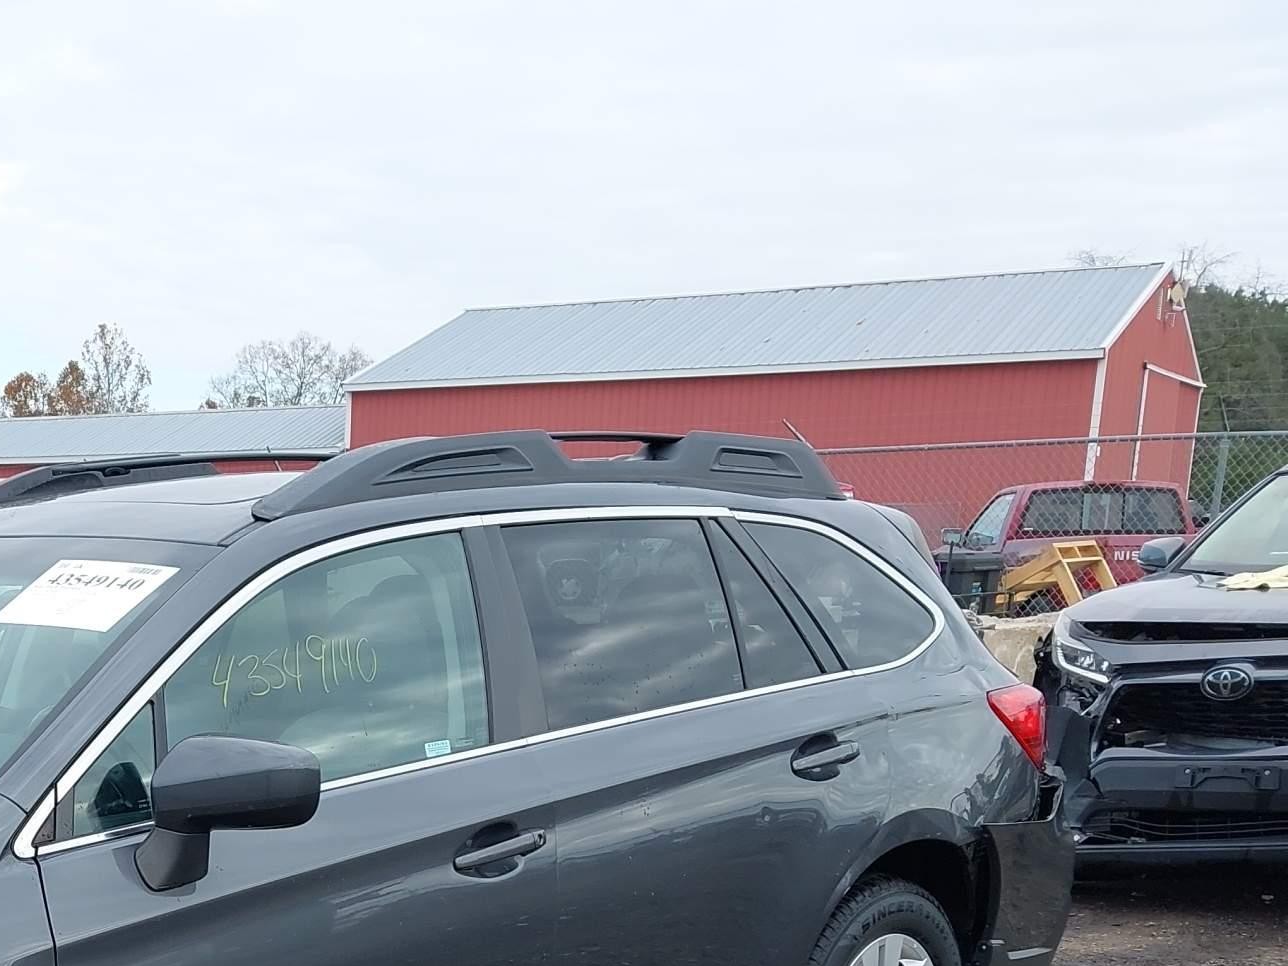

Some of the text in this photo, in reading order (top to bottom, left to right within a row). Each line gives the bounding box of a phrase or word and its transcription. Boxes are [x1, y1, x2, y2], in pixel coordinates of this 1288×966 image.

[1113, 550, 1140, 561] NIS
[48, 573, 146, 591] 43549140
[212, 634, 377, 709] 43549140
